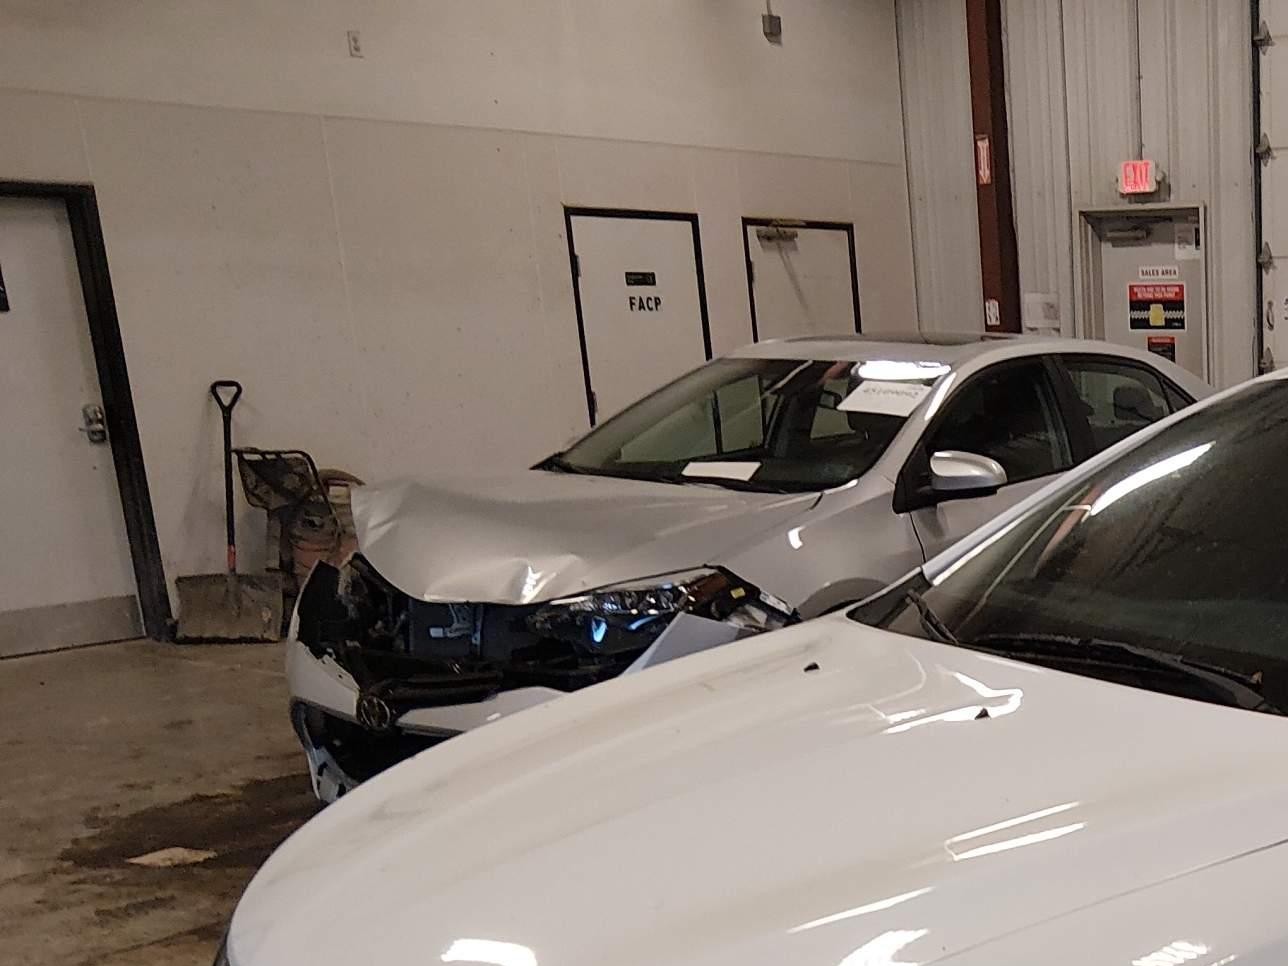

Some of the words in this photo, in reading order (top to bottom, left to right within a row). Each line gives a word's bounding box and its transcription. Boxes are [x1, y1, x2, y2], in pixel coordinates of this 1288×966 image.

[1123, 162, 1150, 186] EXIT
[1141, 269, 1159, 277] SALES
[1161, 268, 1177, 276] AREA
[629, 296, 661, 311] FACP
